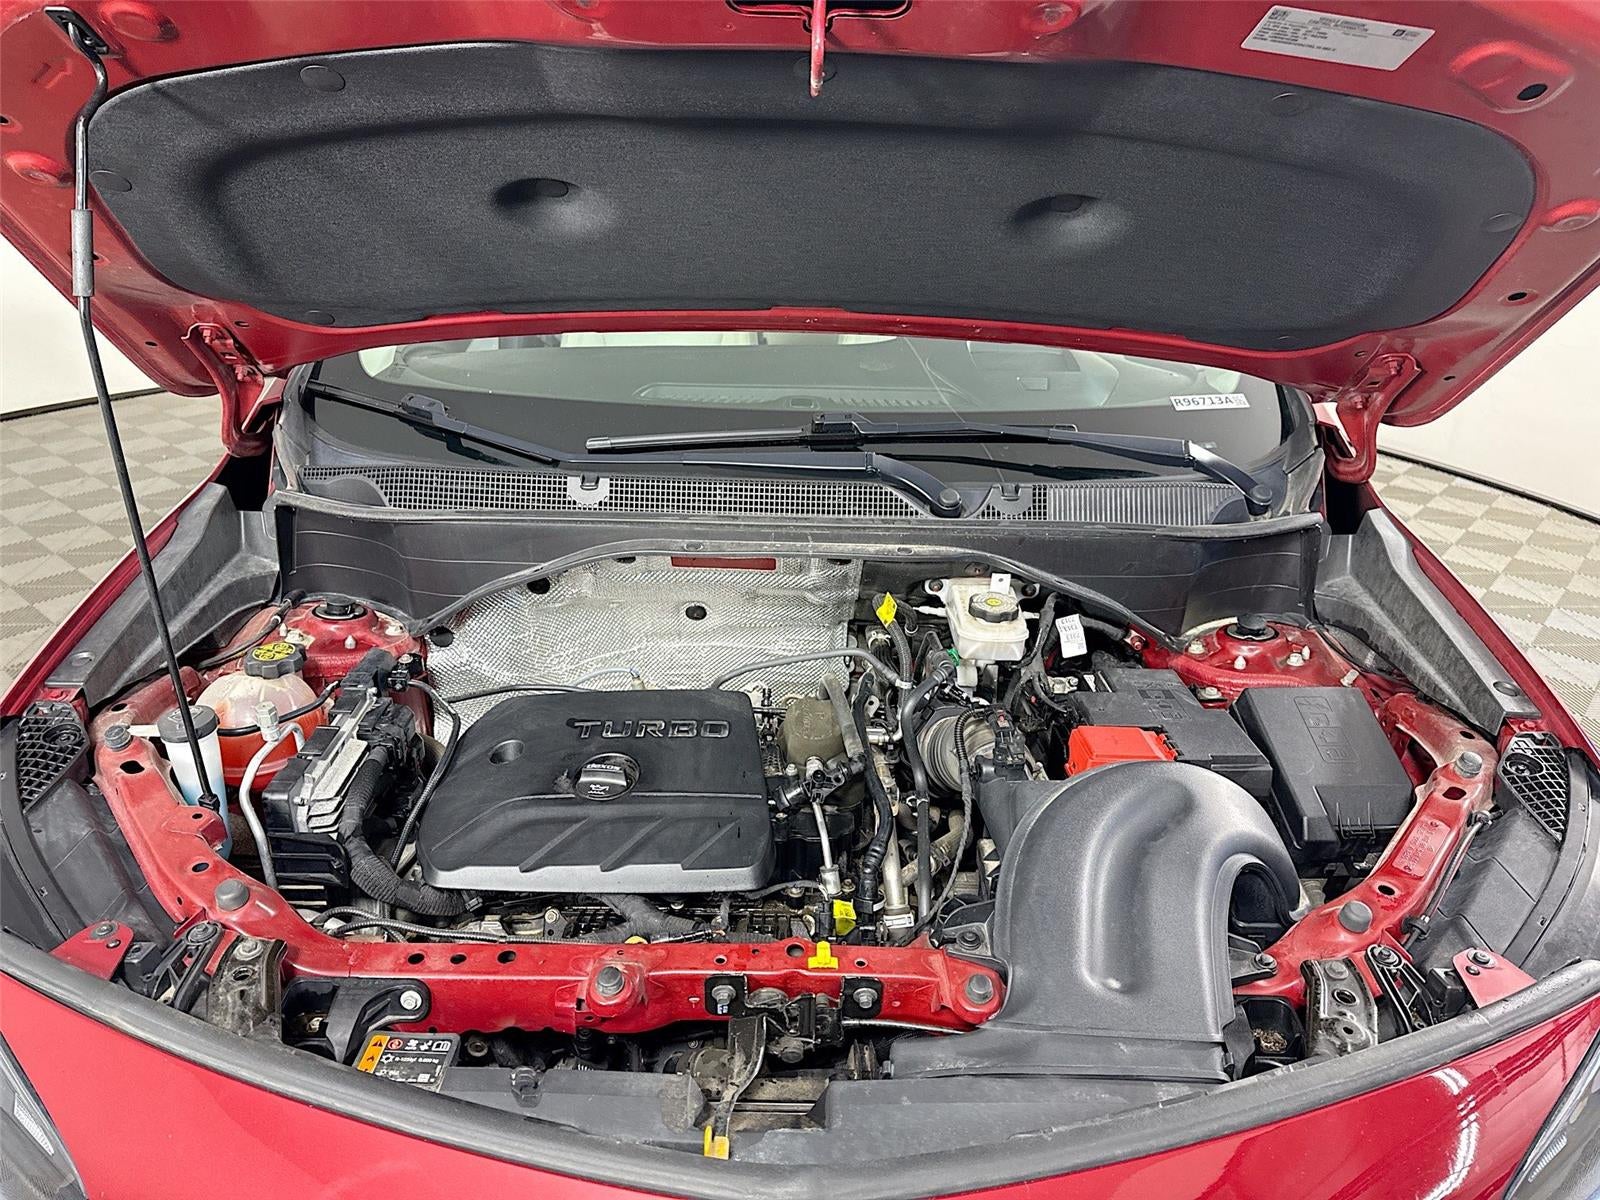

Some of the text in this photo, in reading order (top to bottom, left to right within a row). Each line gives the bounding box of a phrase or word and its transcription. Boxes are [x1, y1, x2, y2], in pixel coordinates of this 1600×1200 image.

[1174, 396, 1234, 407] R96713A
[573, 719, 731, 739] TURBO
[586, 763, 622, 771] dexos
